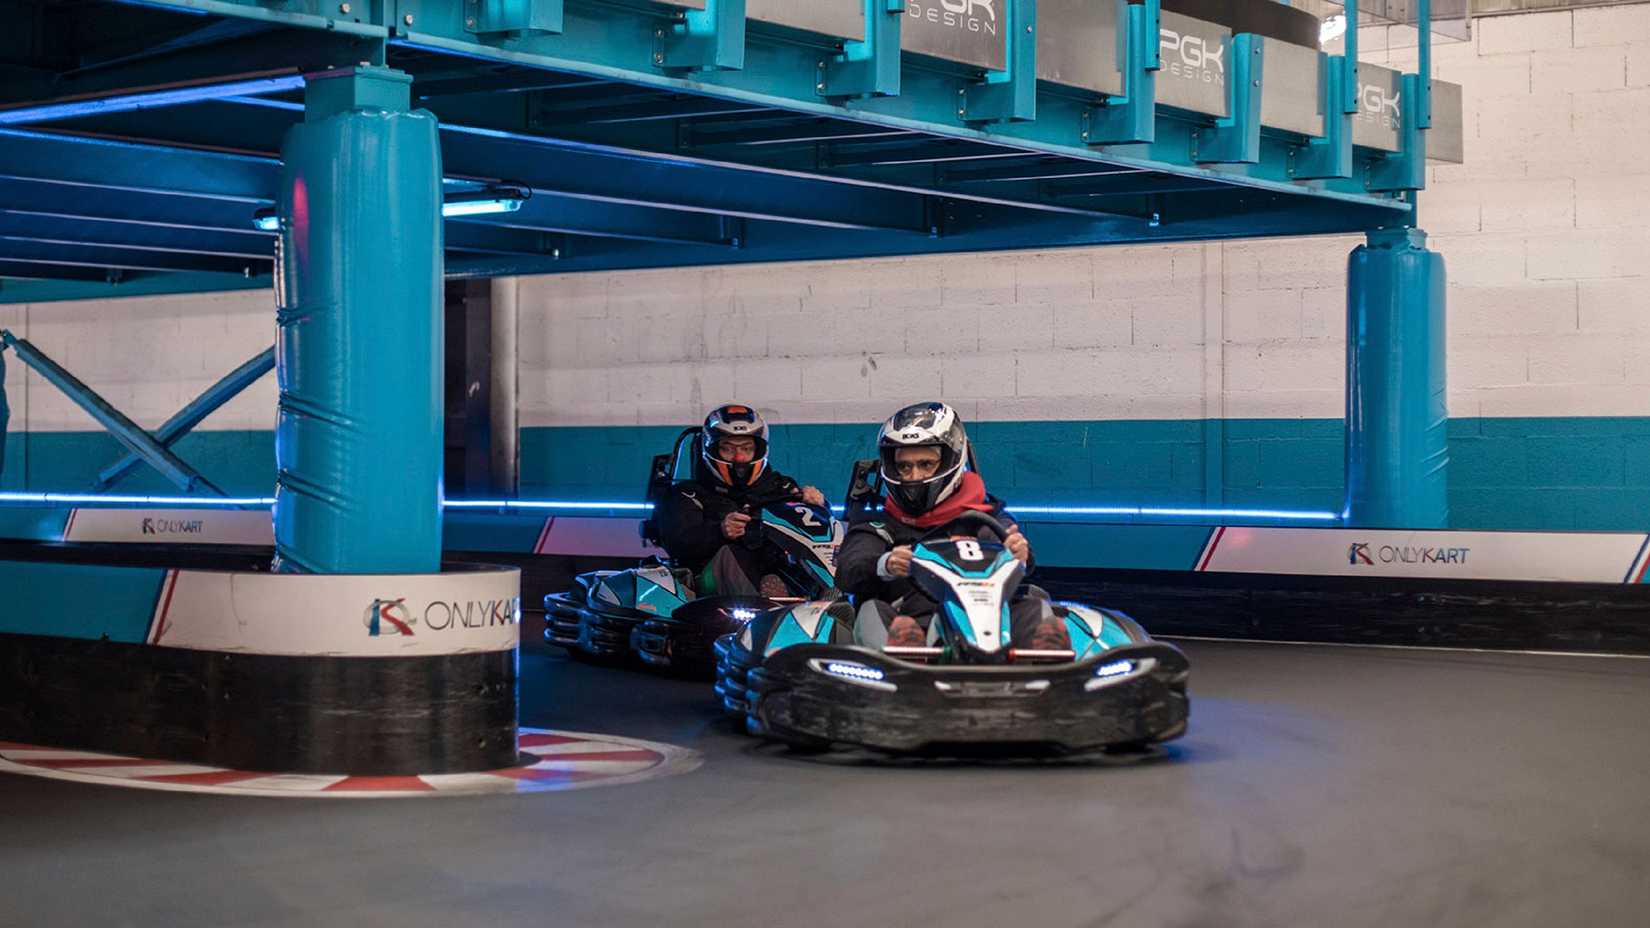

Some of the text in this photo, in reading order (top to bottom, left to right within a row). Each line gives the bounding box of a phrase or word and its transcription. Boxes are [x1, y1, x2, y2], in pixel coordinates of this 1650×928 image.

[909, 3, 995, 36] DESIGN
[1160, 28, 1224, 73] PGK
[1357, 82, 1400, 117] GK
[794, 506, 822, 526] 2
[955, 540, 984, 560] 8
[1379, 545, 1470, 564] ONLYKART
